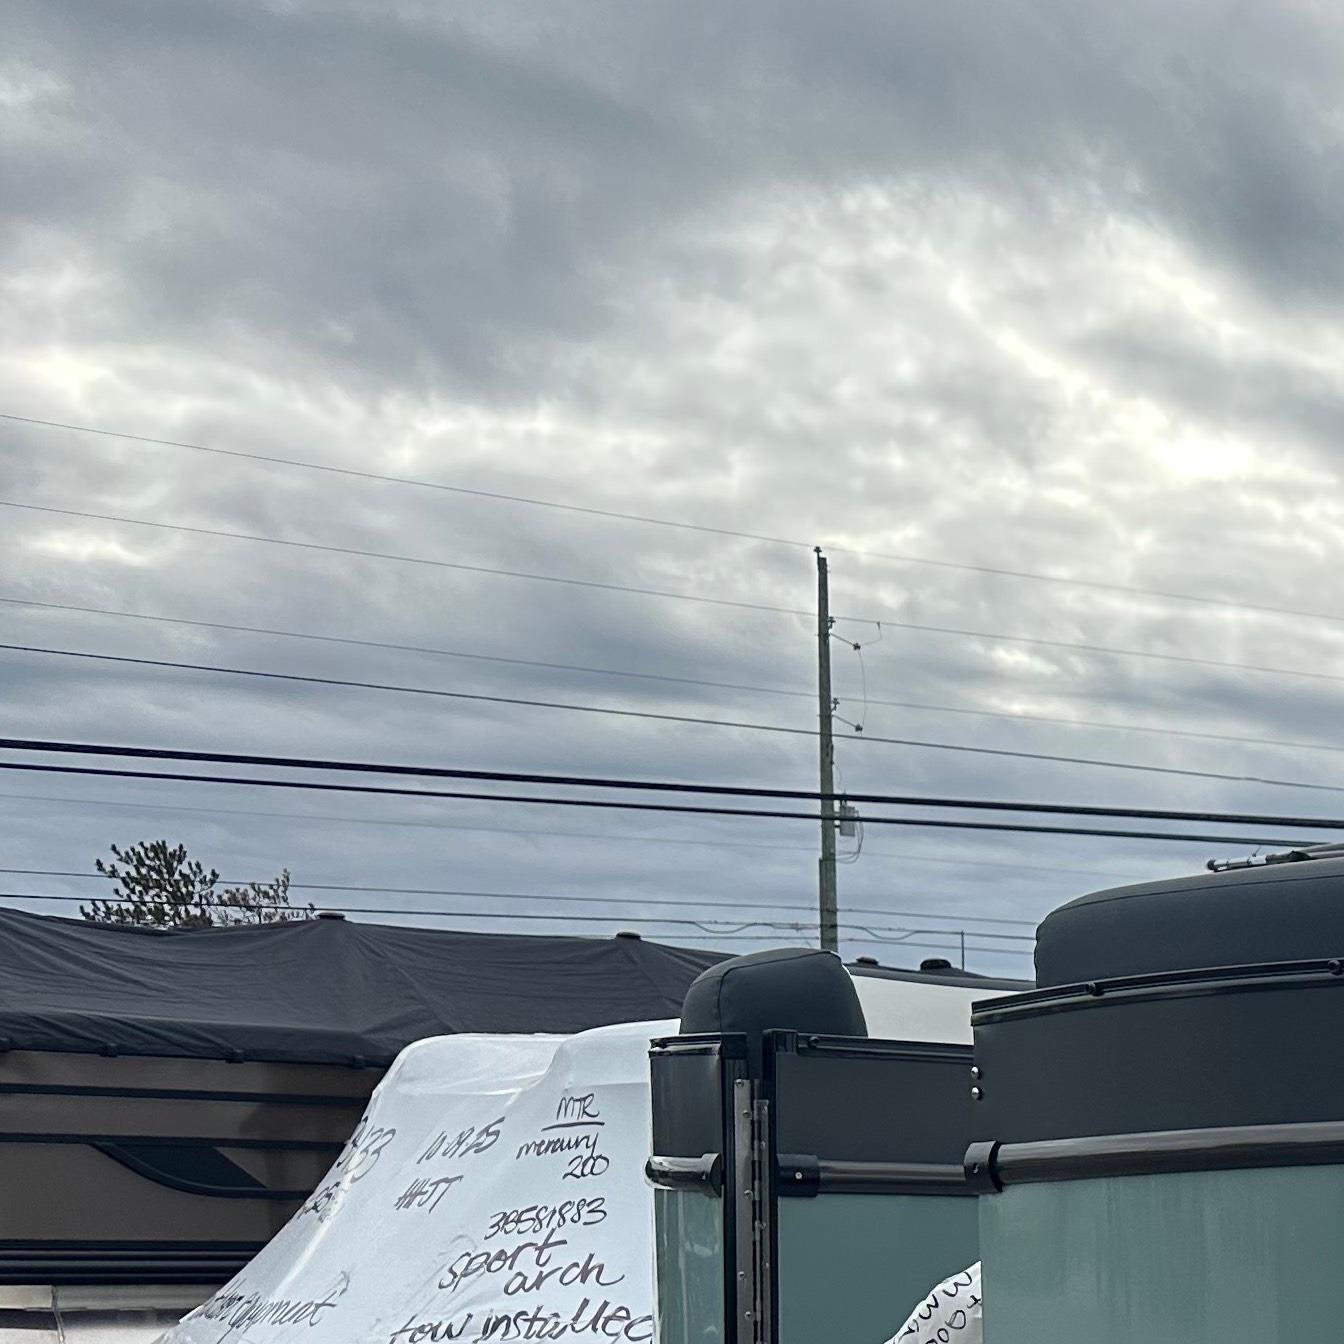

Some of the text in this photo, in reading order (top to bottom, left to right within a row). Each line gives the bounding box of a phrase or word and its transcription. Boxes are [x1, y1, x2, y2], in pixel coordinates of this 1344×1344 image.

[556, 1092, 600, 1120] MTR
[562, 1154, 610, 1180] 200
[438, 1226, 568, 1293] sport
[503, 1253, 625, 1296] arch
